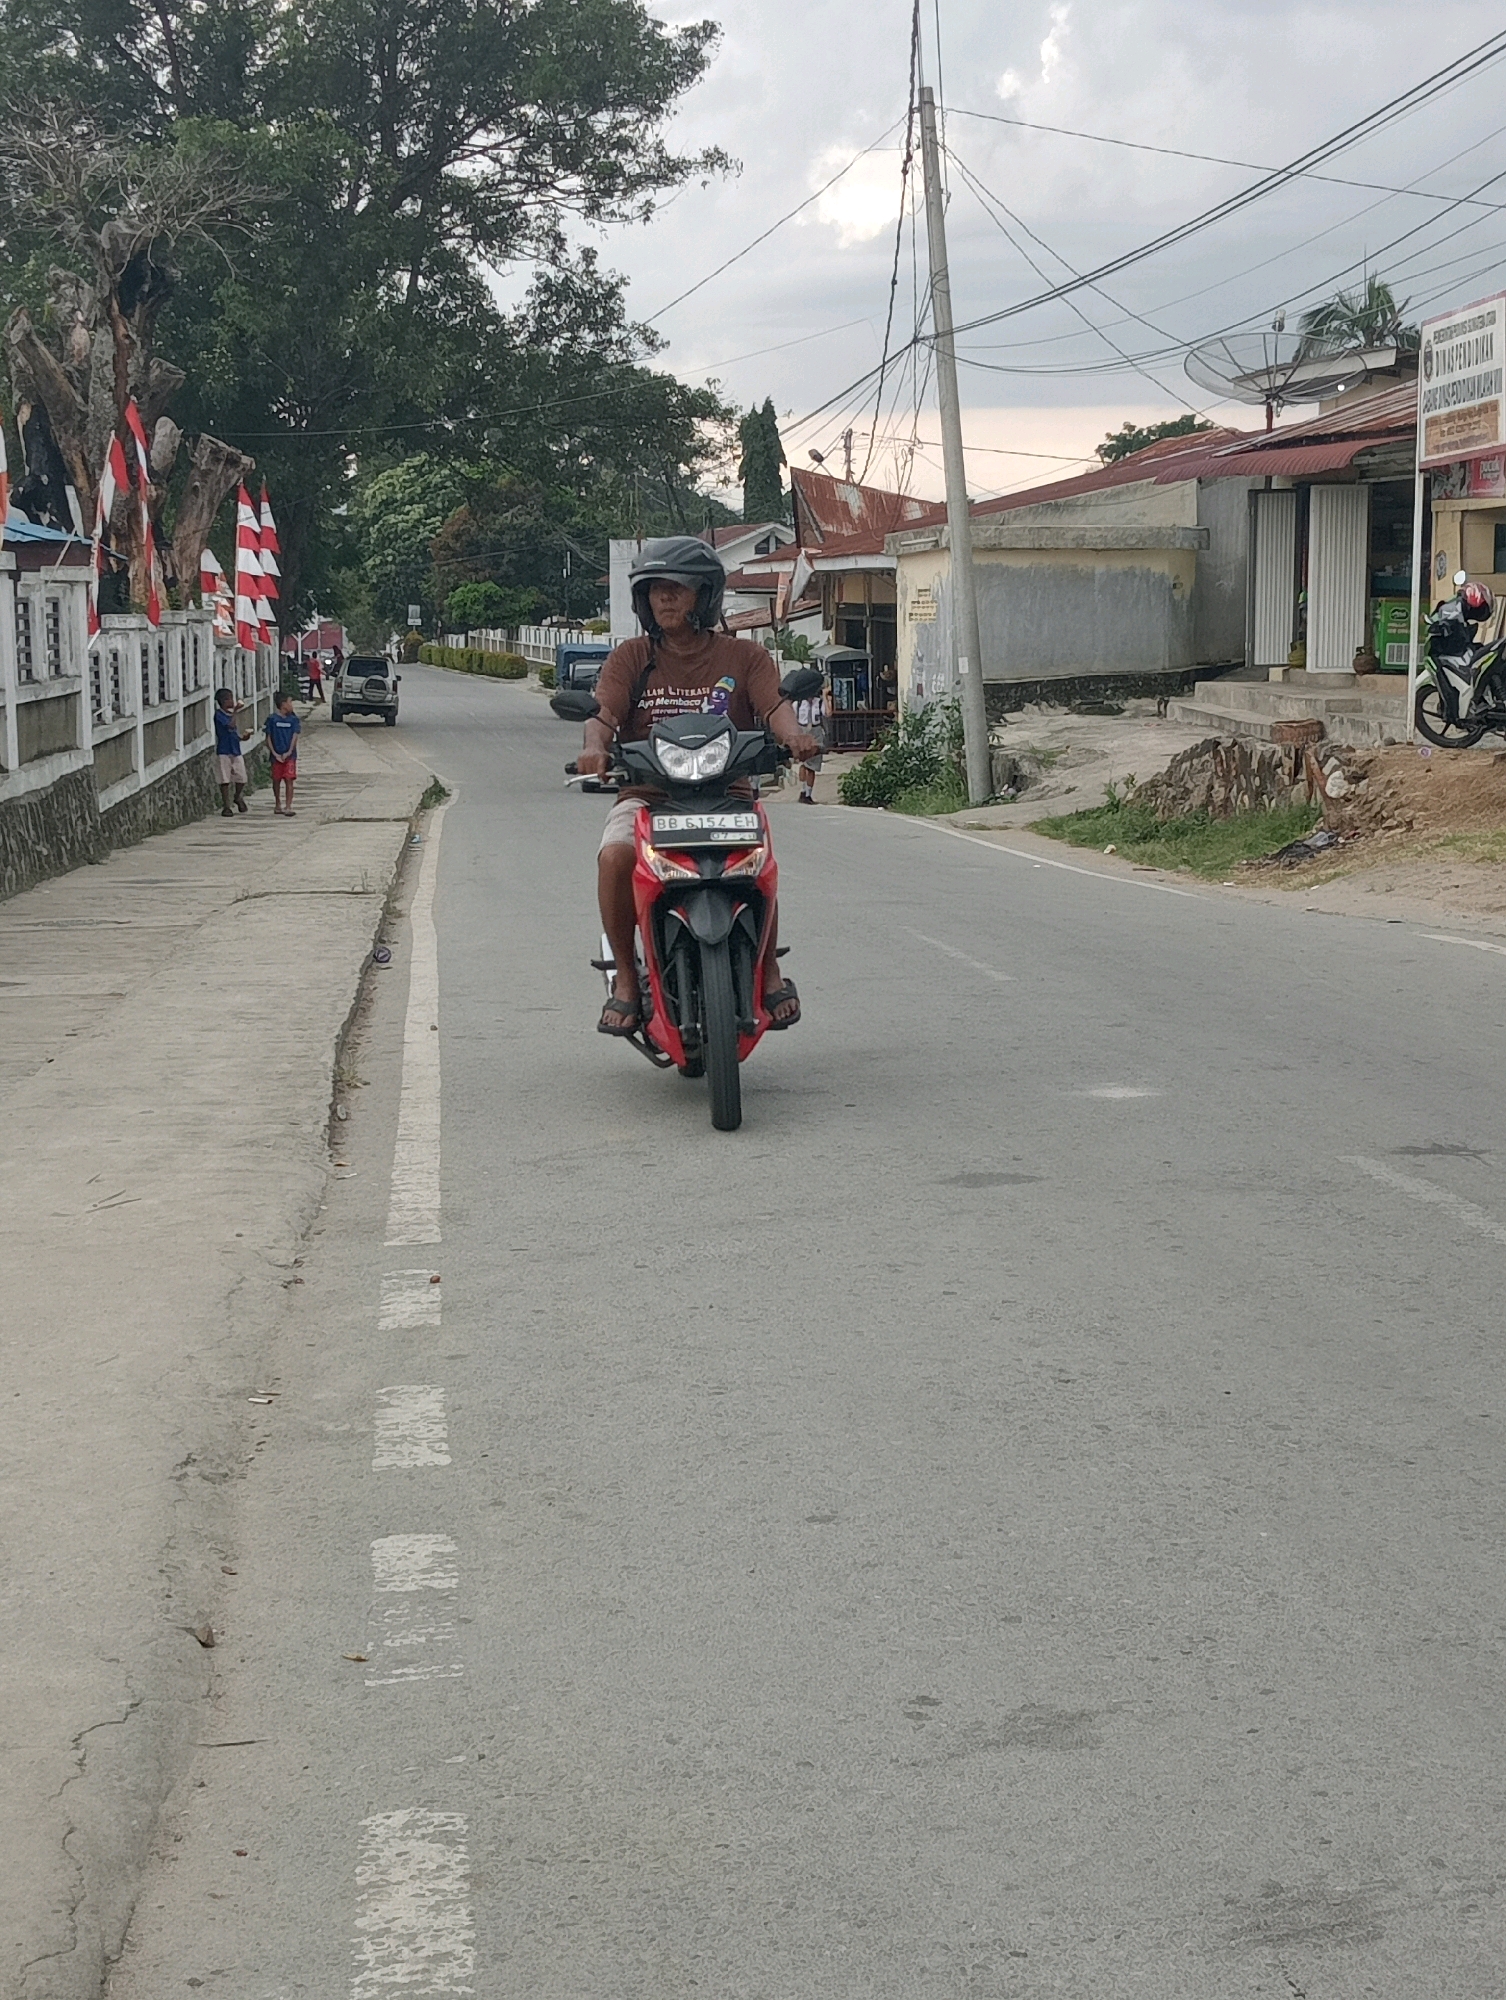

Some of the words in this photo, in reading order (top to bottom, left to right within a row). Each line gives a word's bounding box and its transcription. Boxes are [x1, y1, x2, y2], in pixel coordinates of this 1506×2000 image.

[641, 688, 665, 698] ALAM
[638, 699, 655, 709] Ayo
[657, 818, 678, 830] BB
[734, 816, 755, 828] EH
